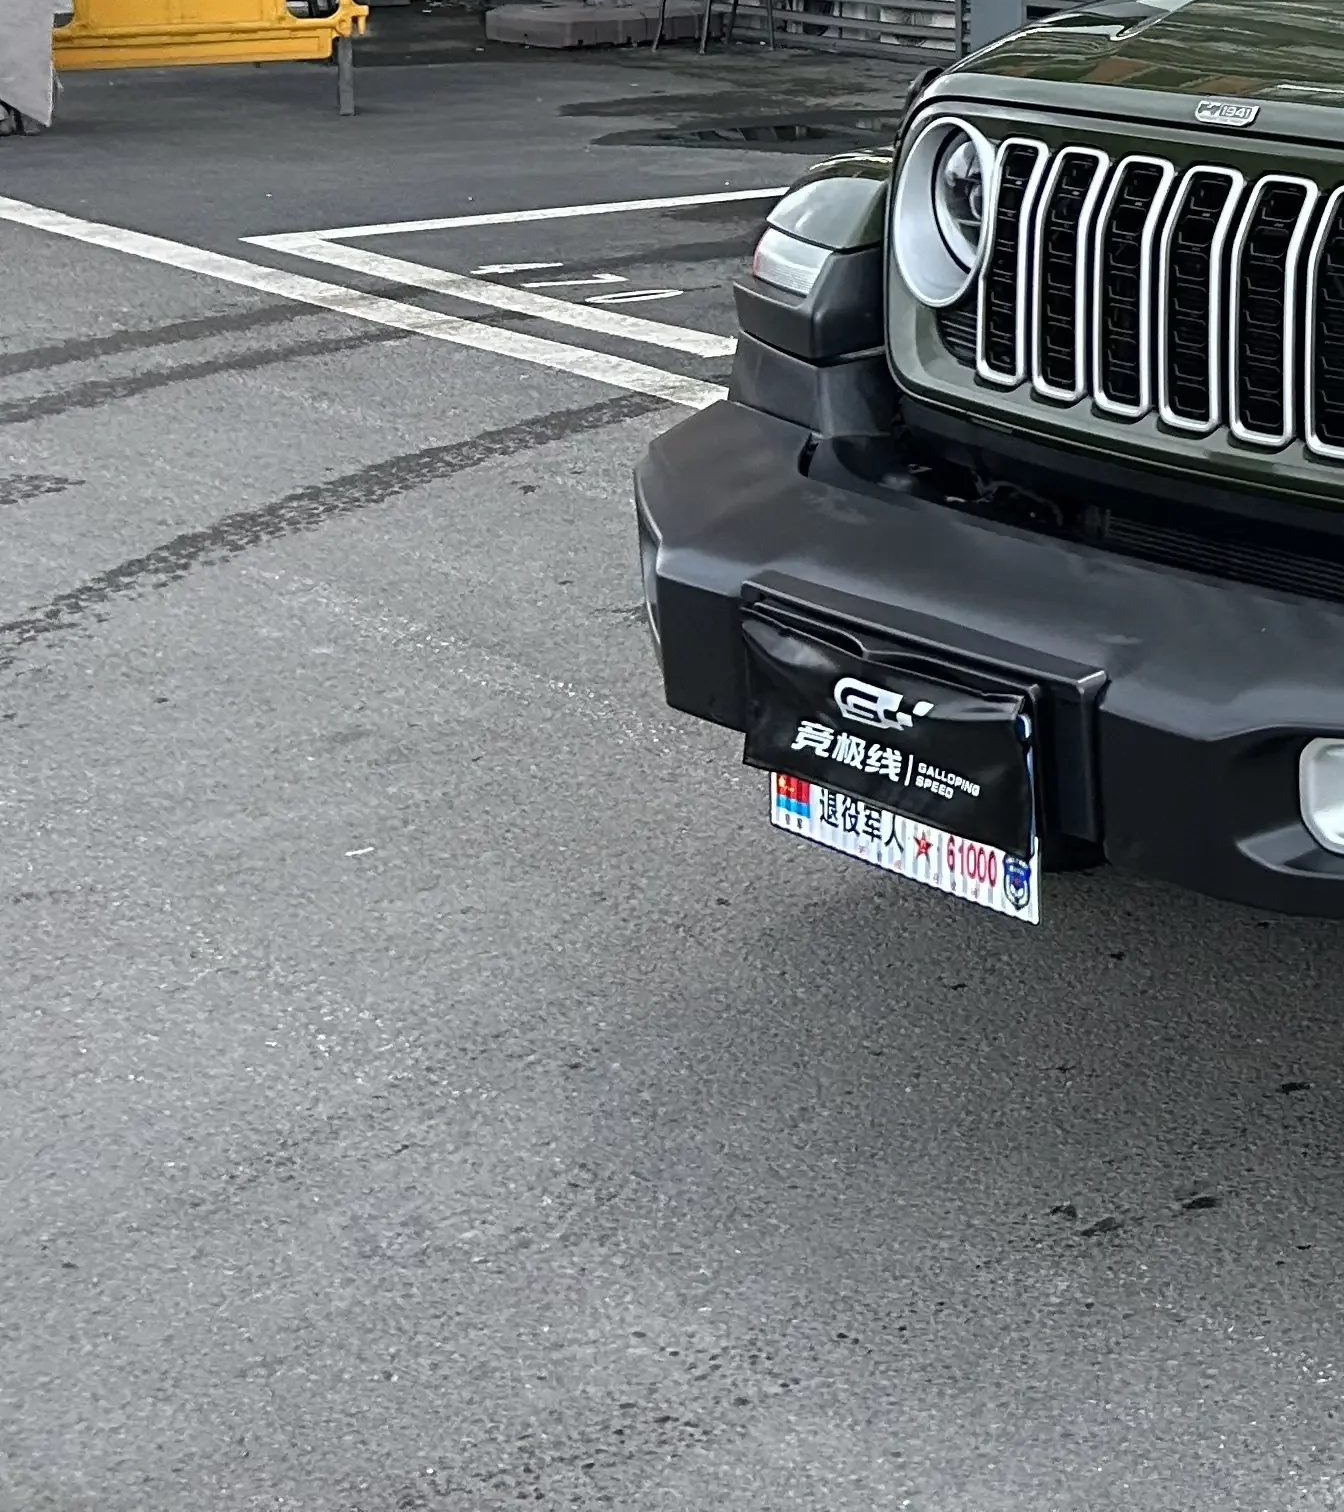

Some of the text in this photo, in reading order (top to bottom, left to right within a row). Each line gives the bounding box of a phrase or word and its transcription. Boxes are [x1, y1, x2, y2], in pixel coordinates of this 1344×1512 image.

[1221, 105, 1251, 119] 1941
[914, 774, 954, 800] SPEED
[917, 762, 981, 798] GALLOPING
[818, 788, 905, 853] 退役军人
